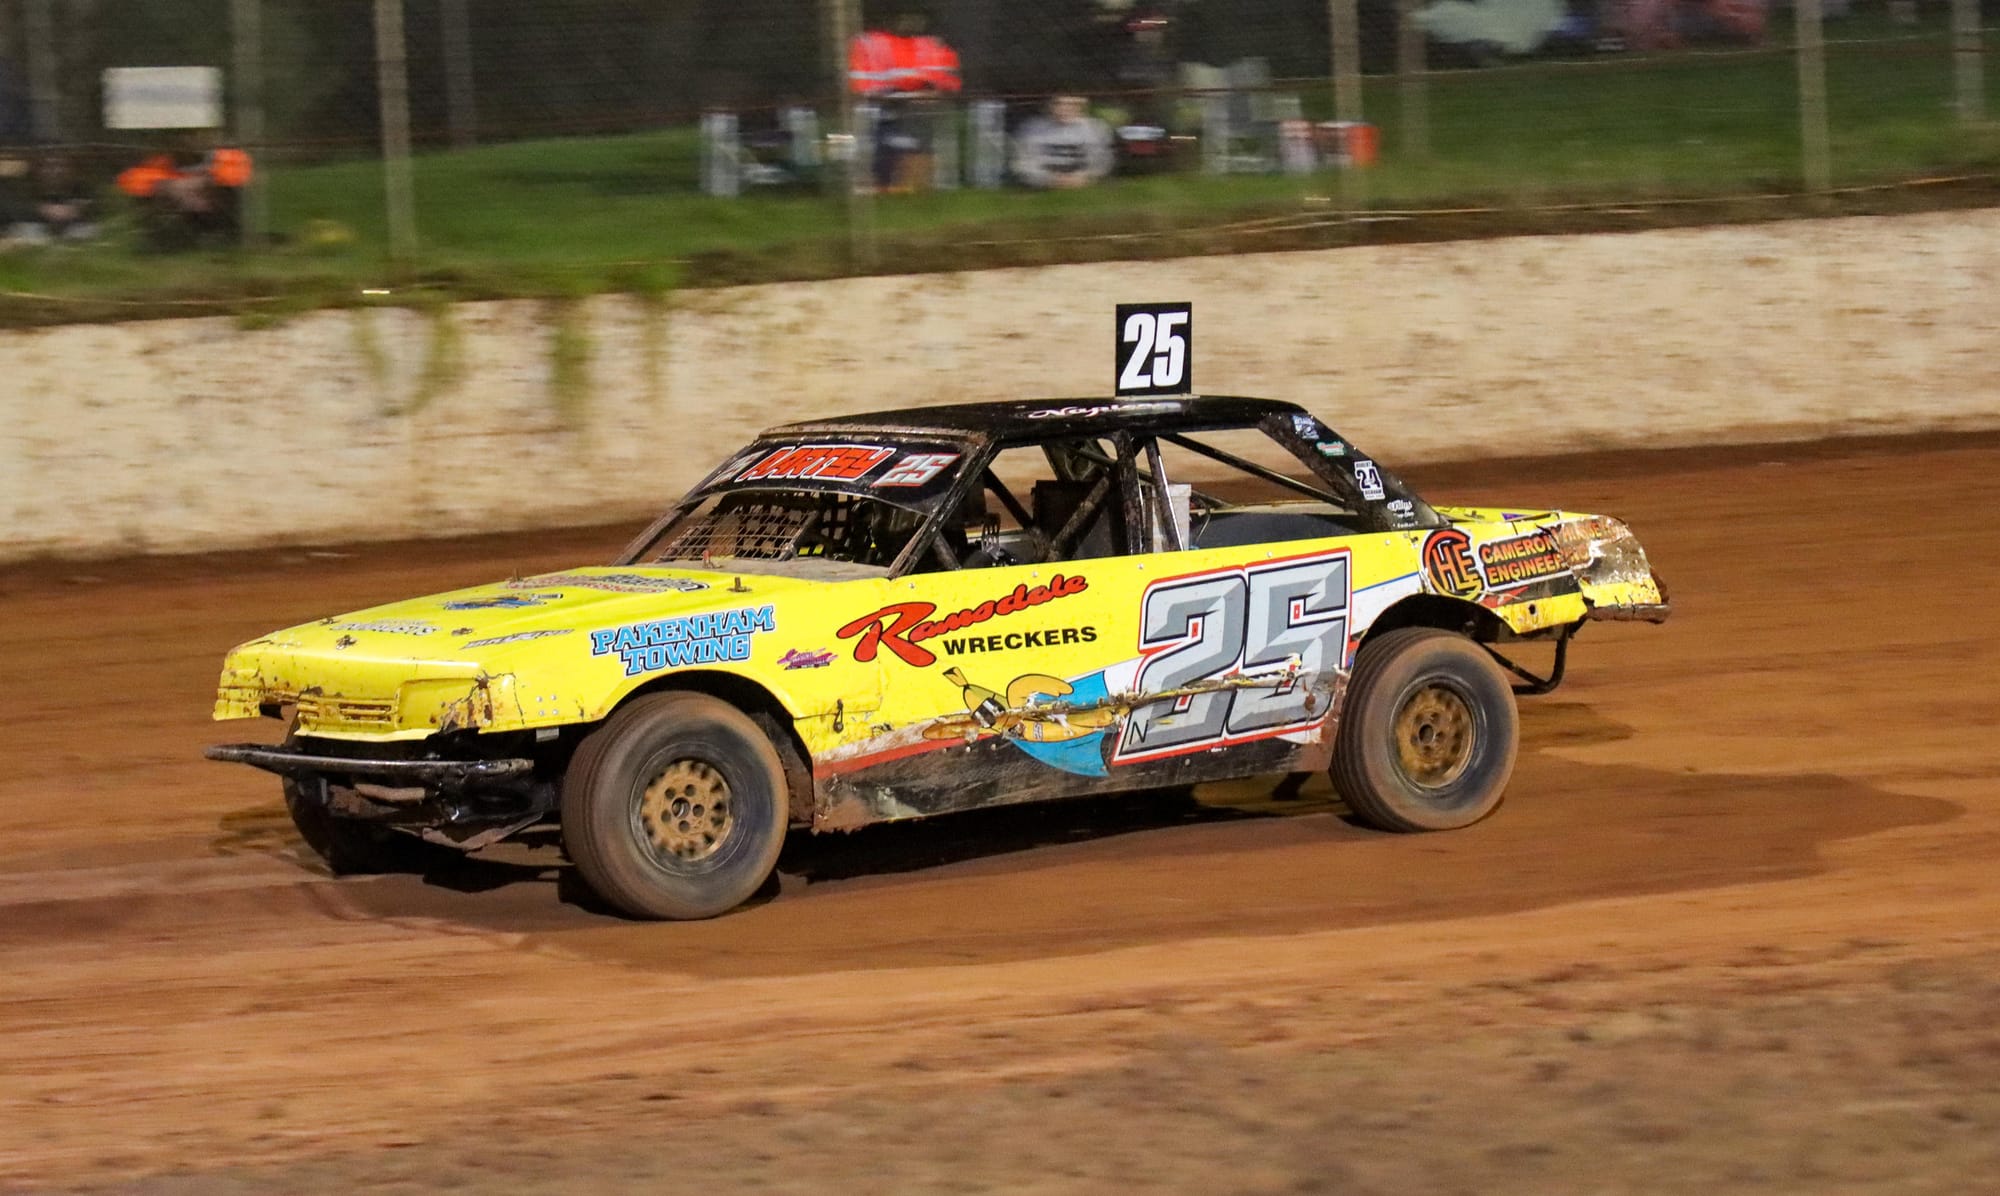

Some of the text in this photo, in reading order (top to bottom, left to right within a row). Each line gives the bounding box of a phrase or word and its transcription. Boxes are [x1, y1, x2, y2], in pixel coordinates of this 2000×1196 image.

[1119, 312, 1188, 389] 25
[869, 453, 961, 488] 25
[1356, 468, 1381, 489] 24
[592, 606, 775, 656] PAKENHAM
[943, 625, 1097, 656] WRECKERS
[622, 633, 751, 676] TOWING
[1113, 548, 1351, 765] 25
